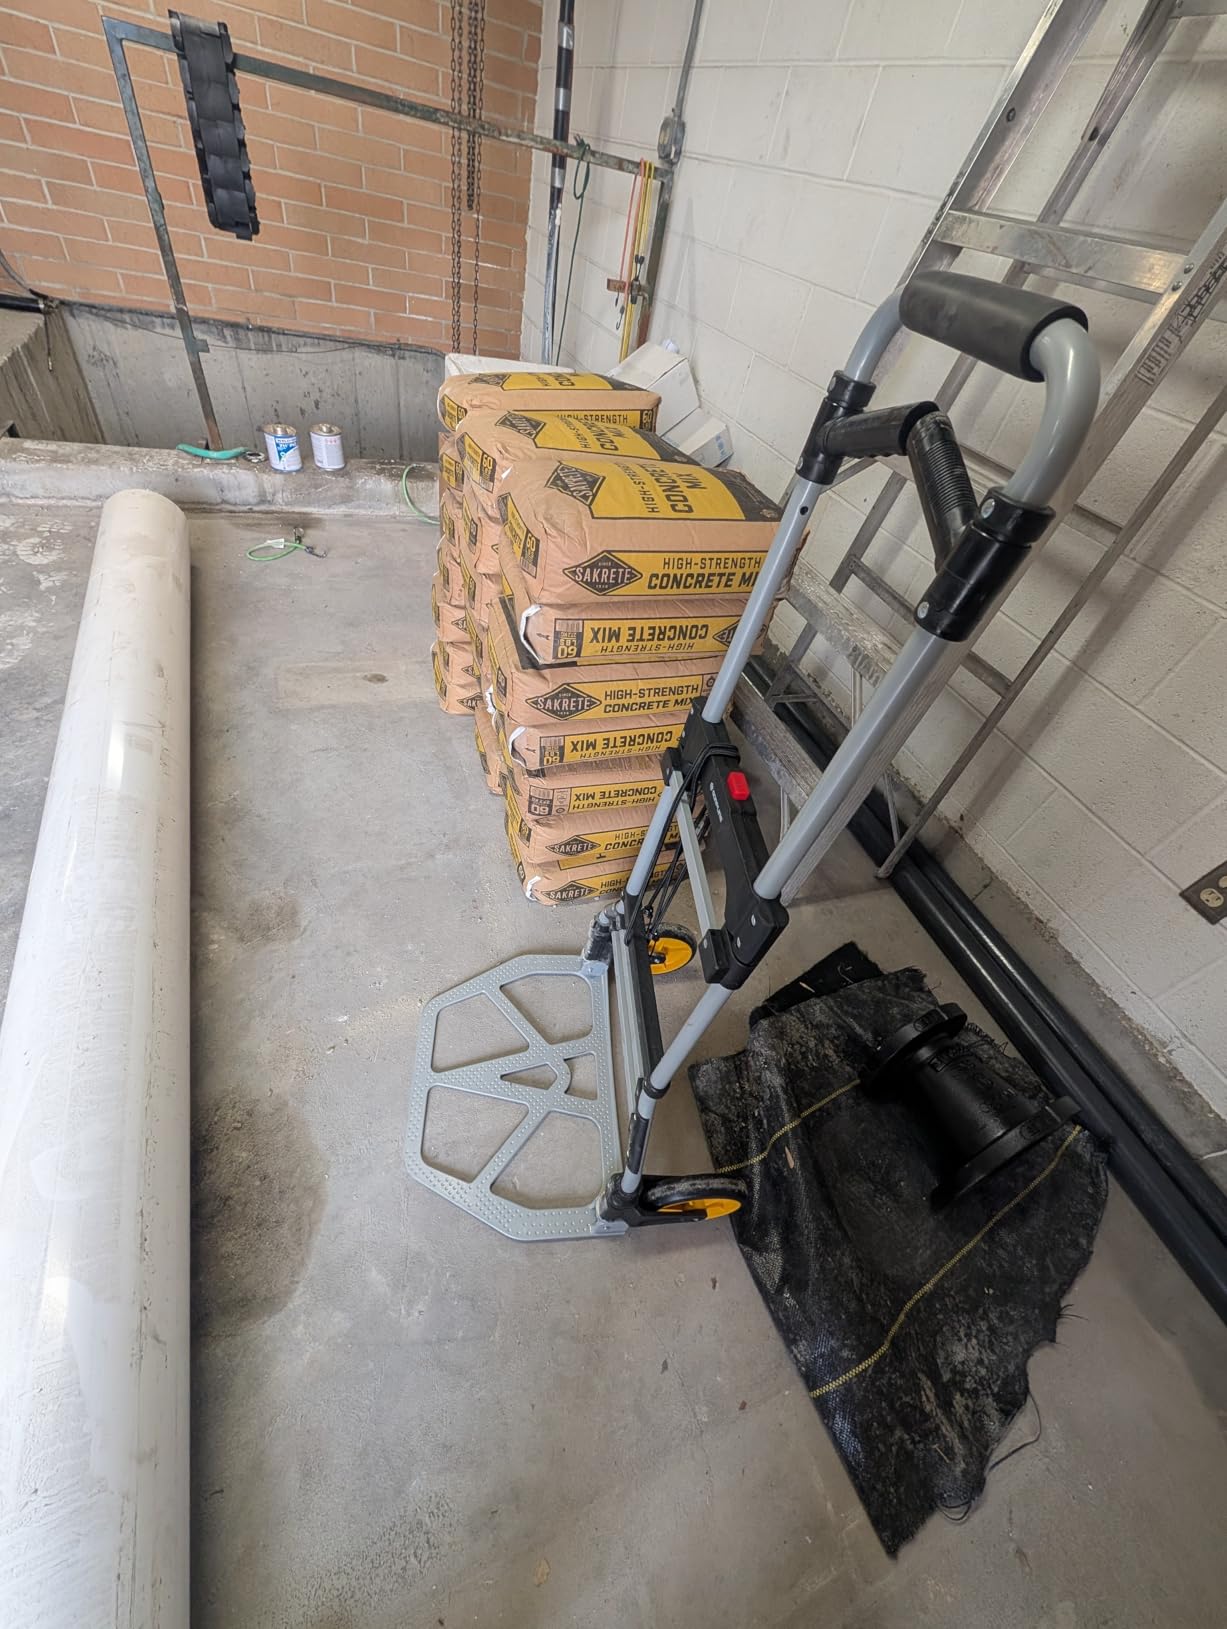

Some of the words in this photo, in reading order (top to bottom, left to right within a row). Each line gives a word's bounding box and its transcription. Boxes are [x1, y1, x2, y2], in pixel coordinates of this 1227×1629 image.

[482, 453, 493, 470] 60
[675, 472, 707, 490] MIX
[527, 533, 536, 552] 60
[663, 557, 762, 570] HIGH-STRENGTH
[575, 567, 632, 584] SAKRETE
[648, 573, 733, 590] CONCRETE
[738, 572, 759, 588] MI
[589, 626, 621, 643] MIX
[626, 624, 709, 643] CONCRETE
[558, 645, 577, 658] 60
[600, 642, 695, 653] HIGH-STRENGTH
[604, 684, 699, 700] HIGH-STRENGTH
[537, 697, 591, 712] SAKRETE
[604, 699, 670, 714] CONCRETE
[571, 738, 597, 753] MIX
[602, 731, 673, 750] CONCRETE
[580, 744, 661, 759] HIGH-STRENGTH
[574, 789, 596, 801] MIX
[600, 786, 657, 799] CONCRETE
[531, 804, 549, 815] 60
[572, 796, 656, 810] HIGH-STRENGTH
[554, 843, 593, 852] SAKRETE
[549, 887, 590, 900] SAKRETE
